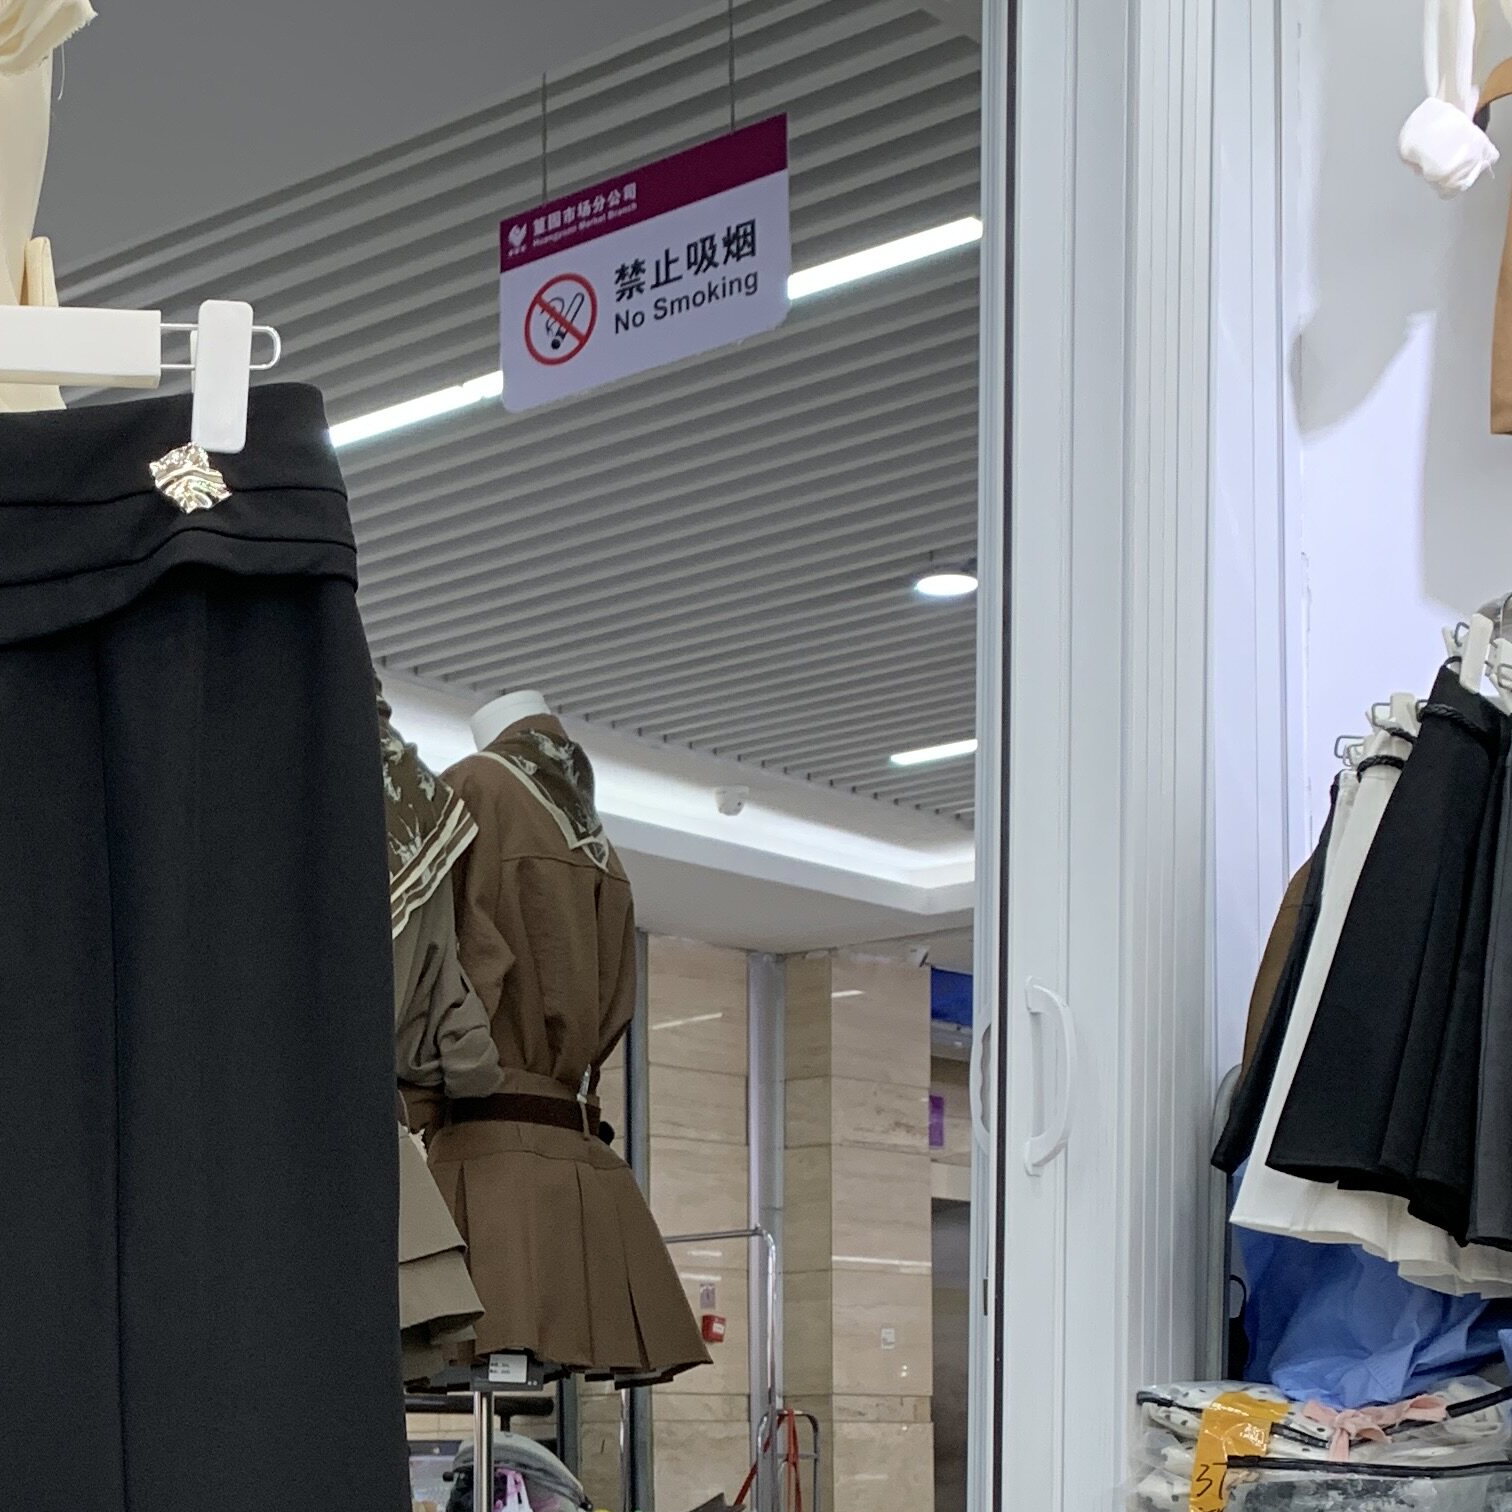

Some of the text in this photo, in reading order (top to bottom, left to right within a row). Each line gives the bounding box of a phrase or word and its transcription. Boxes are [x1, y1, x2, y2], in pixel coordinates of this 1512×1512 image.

[614, 218, 757, 302] 禁止吸烟
[614, 271, 758, 334] No Smoking
